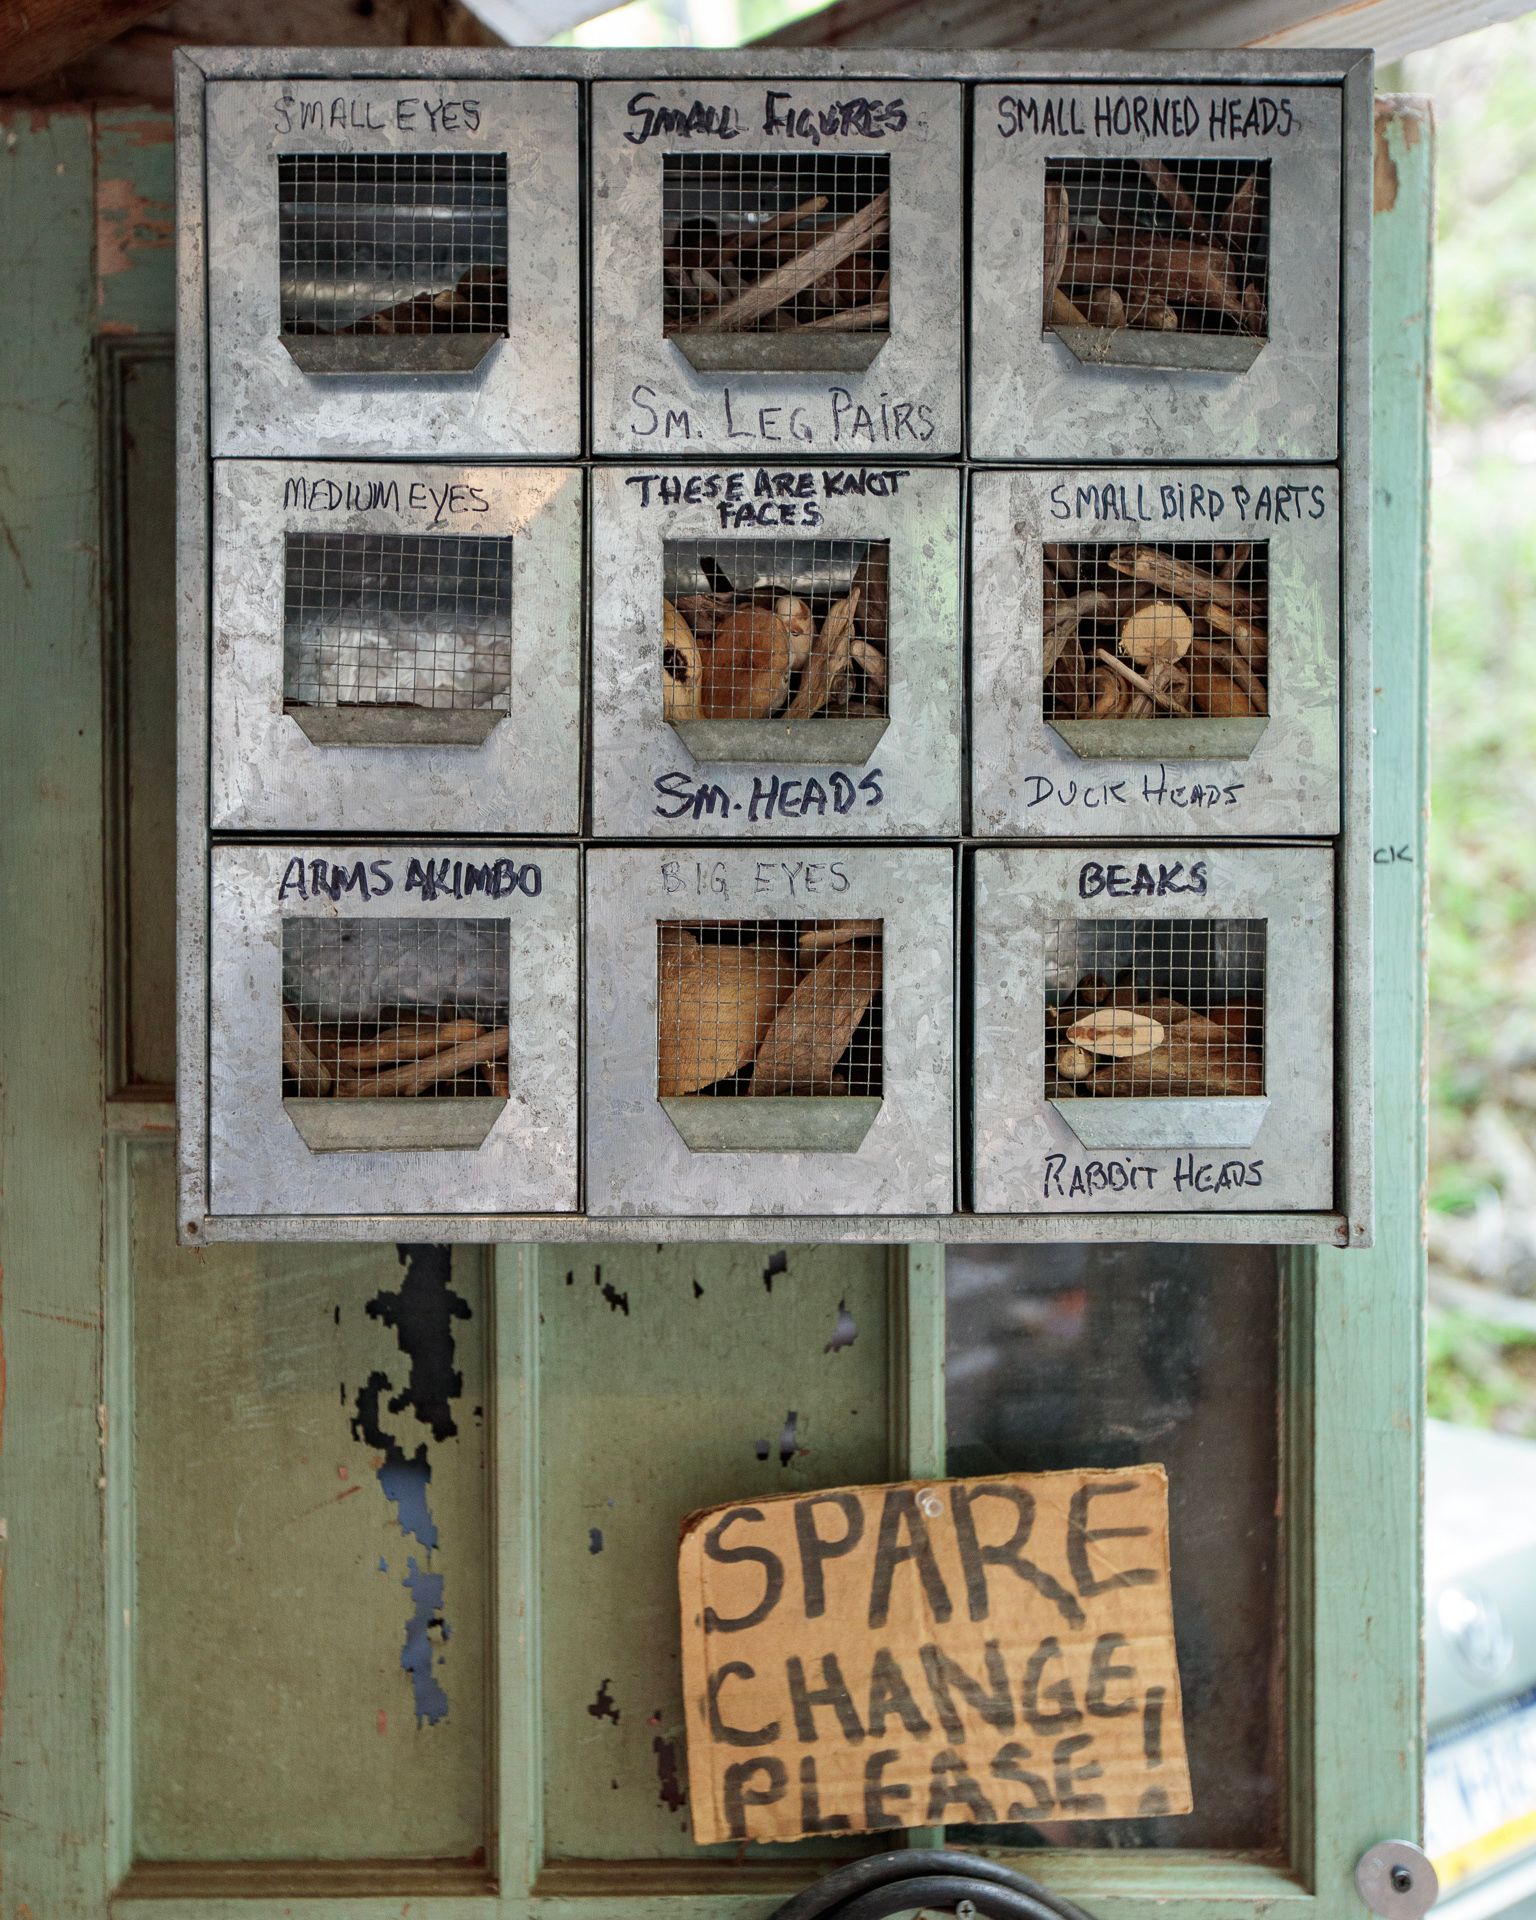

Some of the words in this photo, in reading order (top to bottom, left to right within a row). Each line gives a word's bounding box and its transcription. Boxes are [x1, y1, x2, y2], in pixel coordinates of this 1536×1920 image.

[275, 96, 385, 134] SMALL
[397, 97, 480, 132] EYES
[998, 96, 1085, 138] SMALL
[1095, 97, 1199, 139] HORNED
[1210, 98, 1293, 142] HEADS
[725, 387, 812, 444] LEG
[283, 476, 399, 512] MEDIUM
[410, 482, 490, 524] EYES
[625, 470, 745, 508] THESE
[754, 468, 816, 500] ARE
[821, 468, 910, 499] KNOT
[1050, 484, 1152, 522] SMALL
[1232, 484, 1326, 523] PARTS
[716, 501, 824, 529] FACES
[748, 768, 885, 822] HEADS
[1025, 775, 1126, 808] DUCK
[1143, 764, 1245, 808] HEADS
[278, 857, 394, 901] ARMS
[405, 857, 543, 901] AKIMBO
[661, 861, 728, 894] BIG
[754, 862, 851, 894] EYES
[1078, 862, 1209, 899] BEAKS
[1173, 1154, 1266, 1193] HEADS
[695, 1479, 1163, 1634] SPARE
[702, 1631, 1138, 1747] CHANGE
